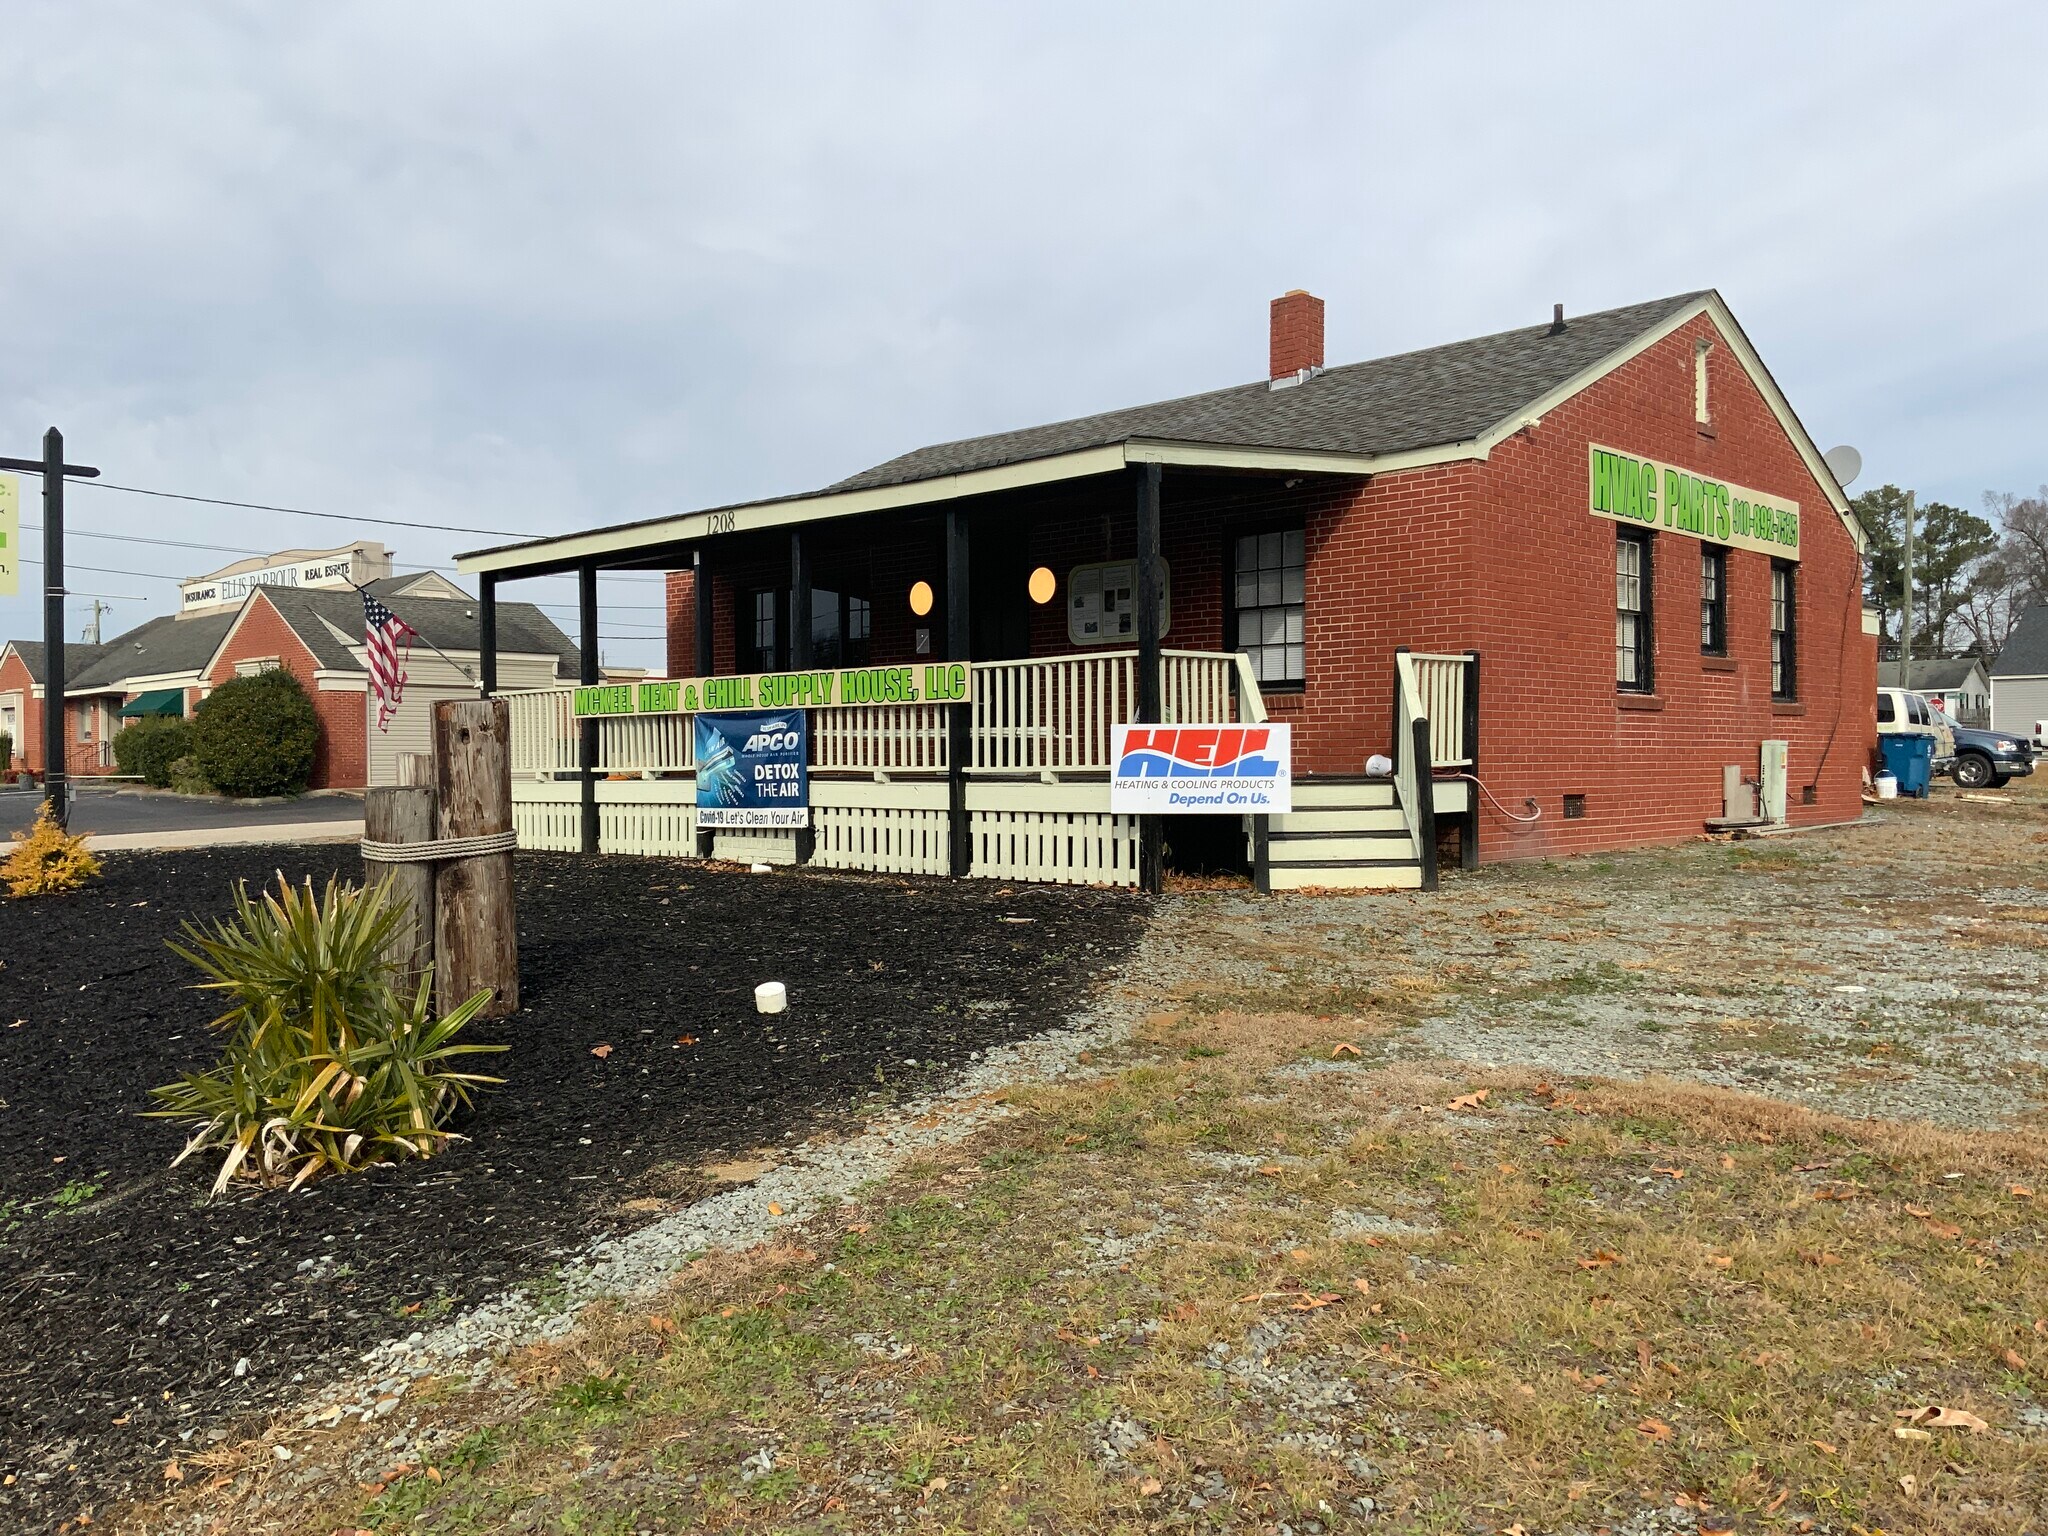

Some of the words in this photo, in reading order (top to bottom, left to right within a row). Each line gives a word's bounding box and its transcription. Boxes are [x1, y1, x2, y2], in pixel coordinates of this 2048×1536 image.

[1593, 449, 1657, 523] HVAC
[1664, 469, 1730, 540] PARTS
[1732, 498, 1798, 548] 910-892-7525
[706, 511, 735, 536] 1208
[304, 568, 323, 581] REAL
[184, 588, 216, 604] INSURANCE
[222, 577, 247, 600] ELLIS
[575, 685, 634, 715] MCKEEL
[639, 682, 680, 712] HEAT
[685, 685, 699, 710] &
[703, 677, 754, 709] CHILL
[759, 671, 834, 707] SUPPLY
[841, 667, 919, 704] HOUSE,
[925, 664, 966, 700] LLC
[742, 732, 799, 752] APCO
[1117, 729, 1280, 777] HEIL
[755, 763, 799, 780] DETOX
[755, 783, 778, 798] THE
[779, 782, 799, 797] AIR
[1114, 780, 1159, 789] HEATING
[1161, 780, 1169, 789] &
[1171, 780, 1218, 789] COOLING
[1220, 780, 1275, 789] PRODUCTS
[1169, 792, 1225, 807] Depend
[1226, 793, 1248, 804] On
[1250, 792, 1271, 805] Us.
[700, 811, 724, 824] Covid-19
[725, 811, 744, 824] Let's
[746, 811, 768, 824] Clean
[770, 811, 789, 824] Your
[790, 811, 804, 824] Air
